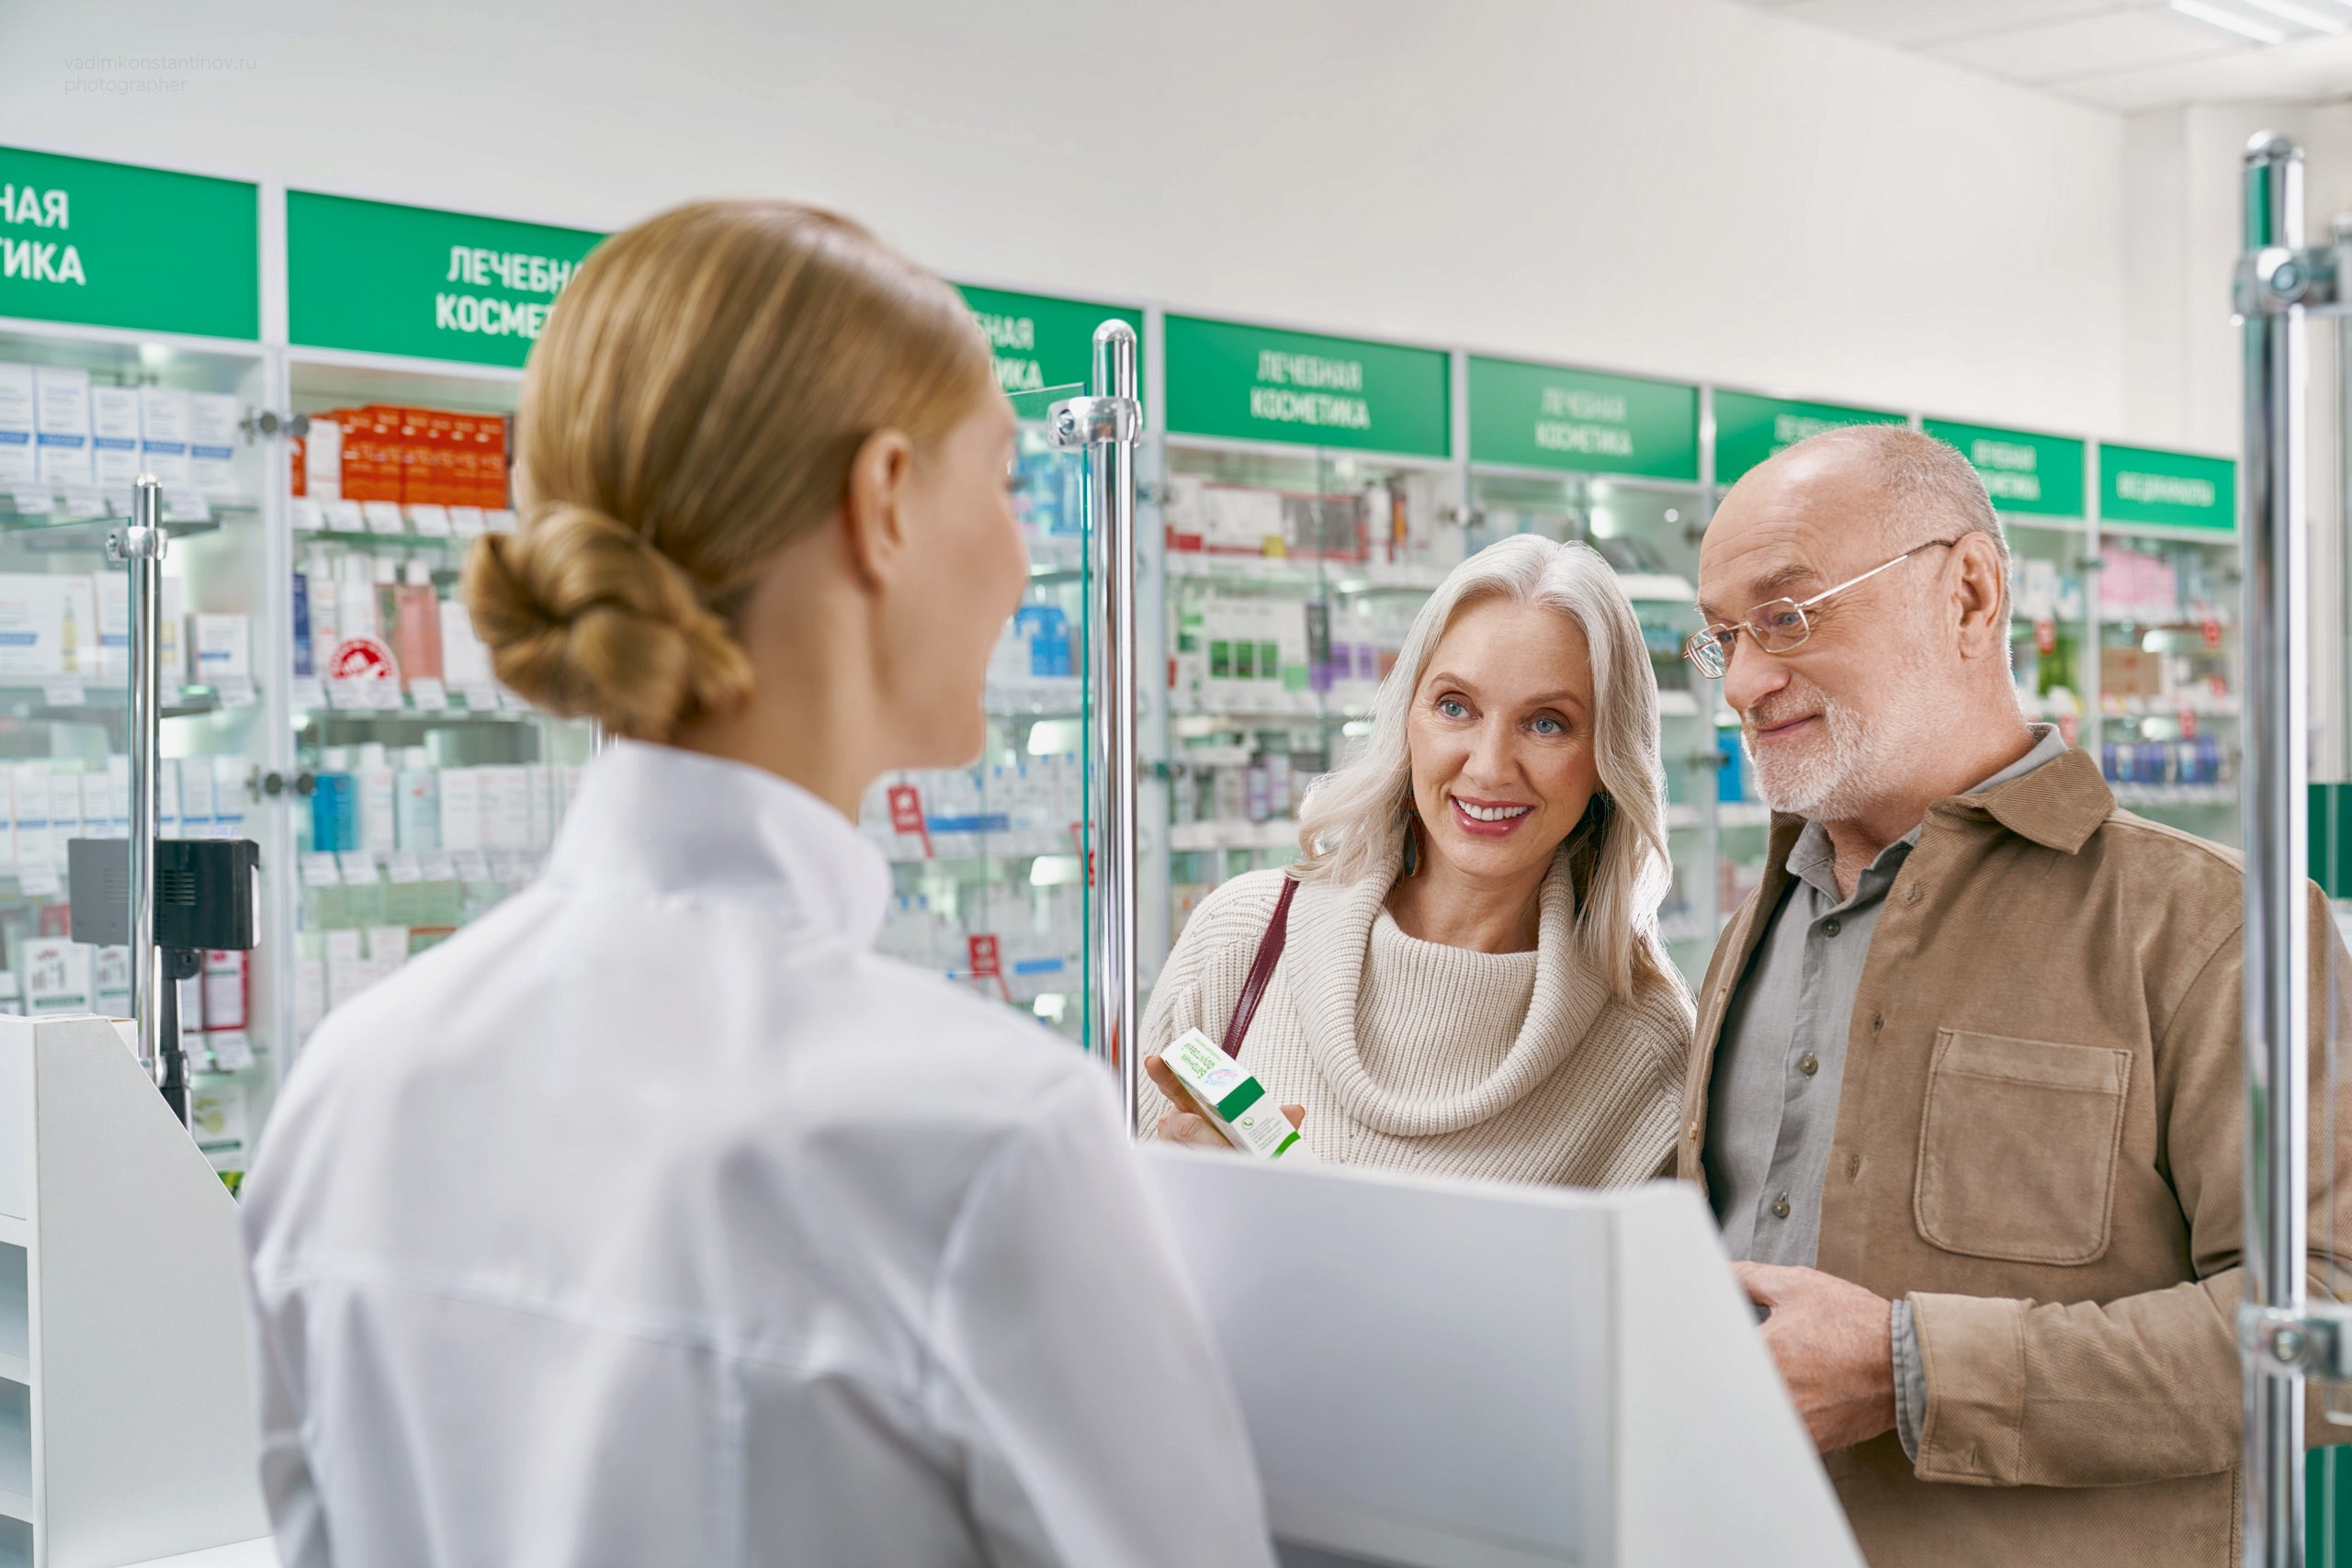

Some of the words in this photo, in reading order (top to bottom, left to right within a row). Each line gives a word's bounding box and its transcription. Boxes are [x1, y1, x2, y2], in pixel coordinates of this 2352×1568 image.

[446, 244, 585, 295] ЛЕЧЕБН
[1256, 350, 1363, 392] ЛЕЧЕБНАЯ
[1250, 386, 1372, 430] КОСМЕТИКА
